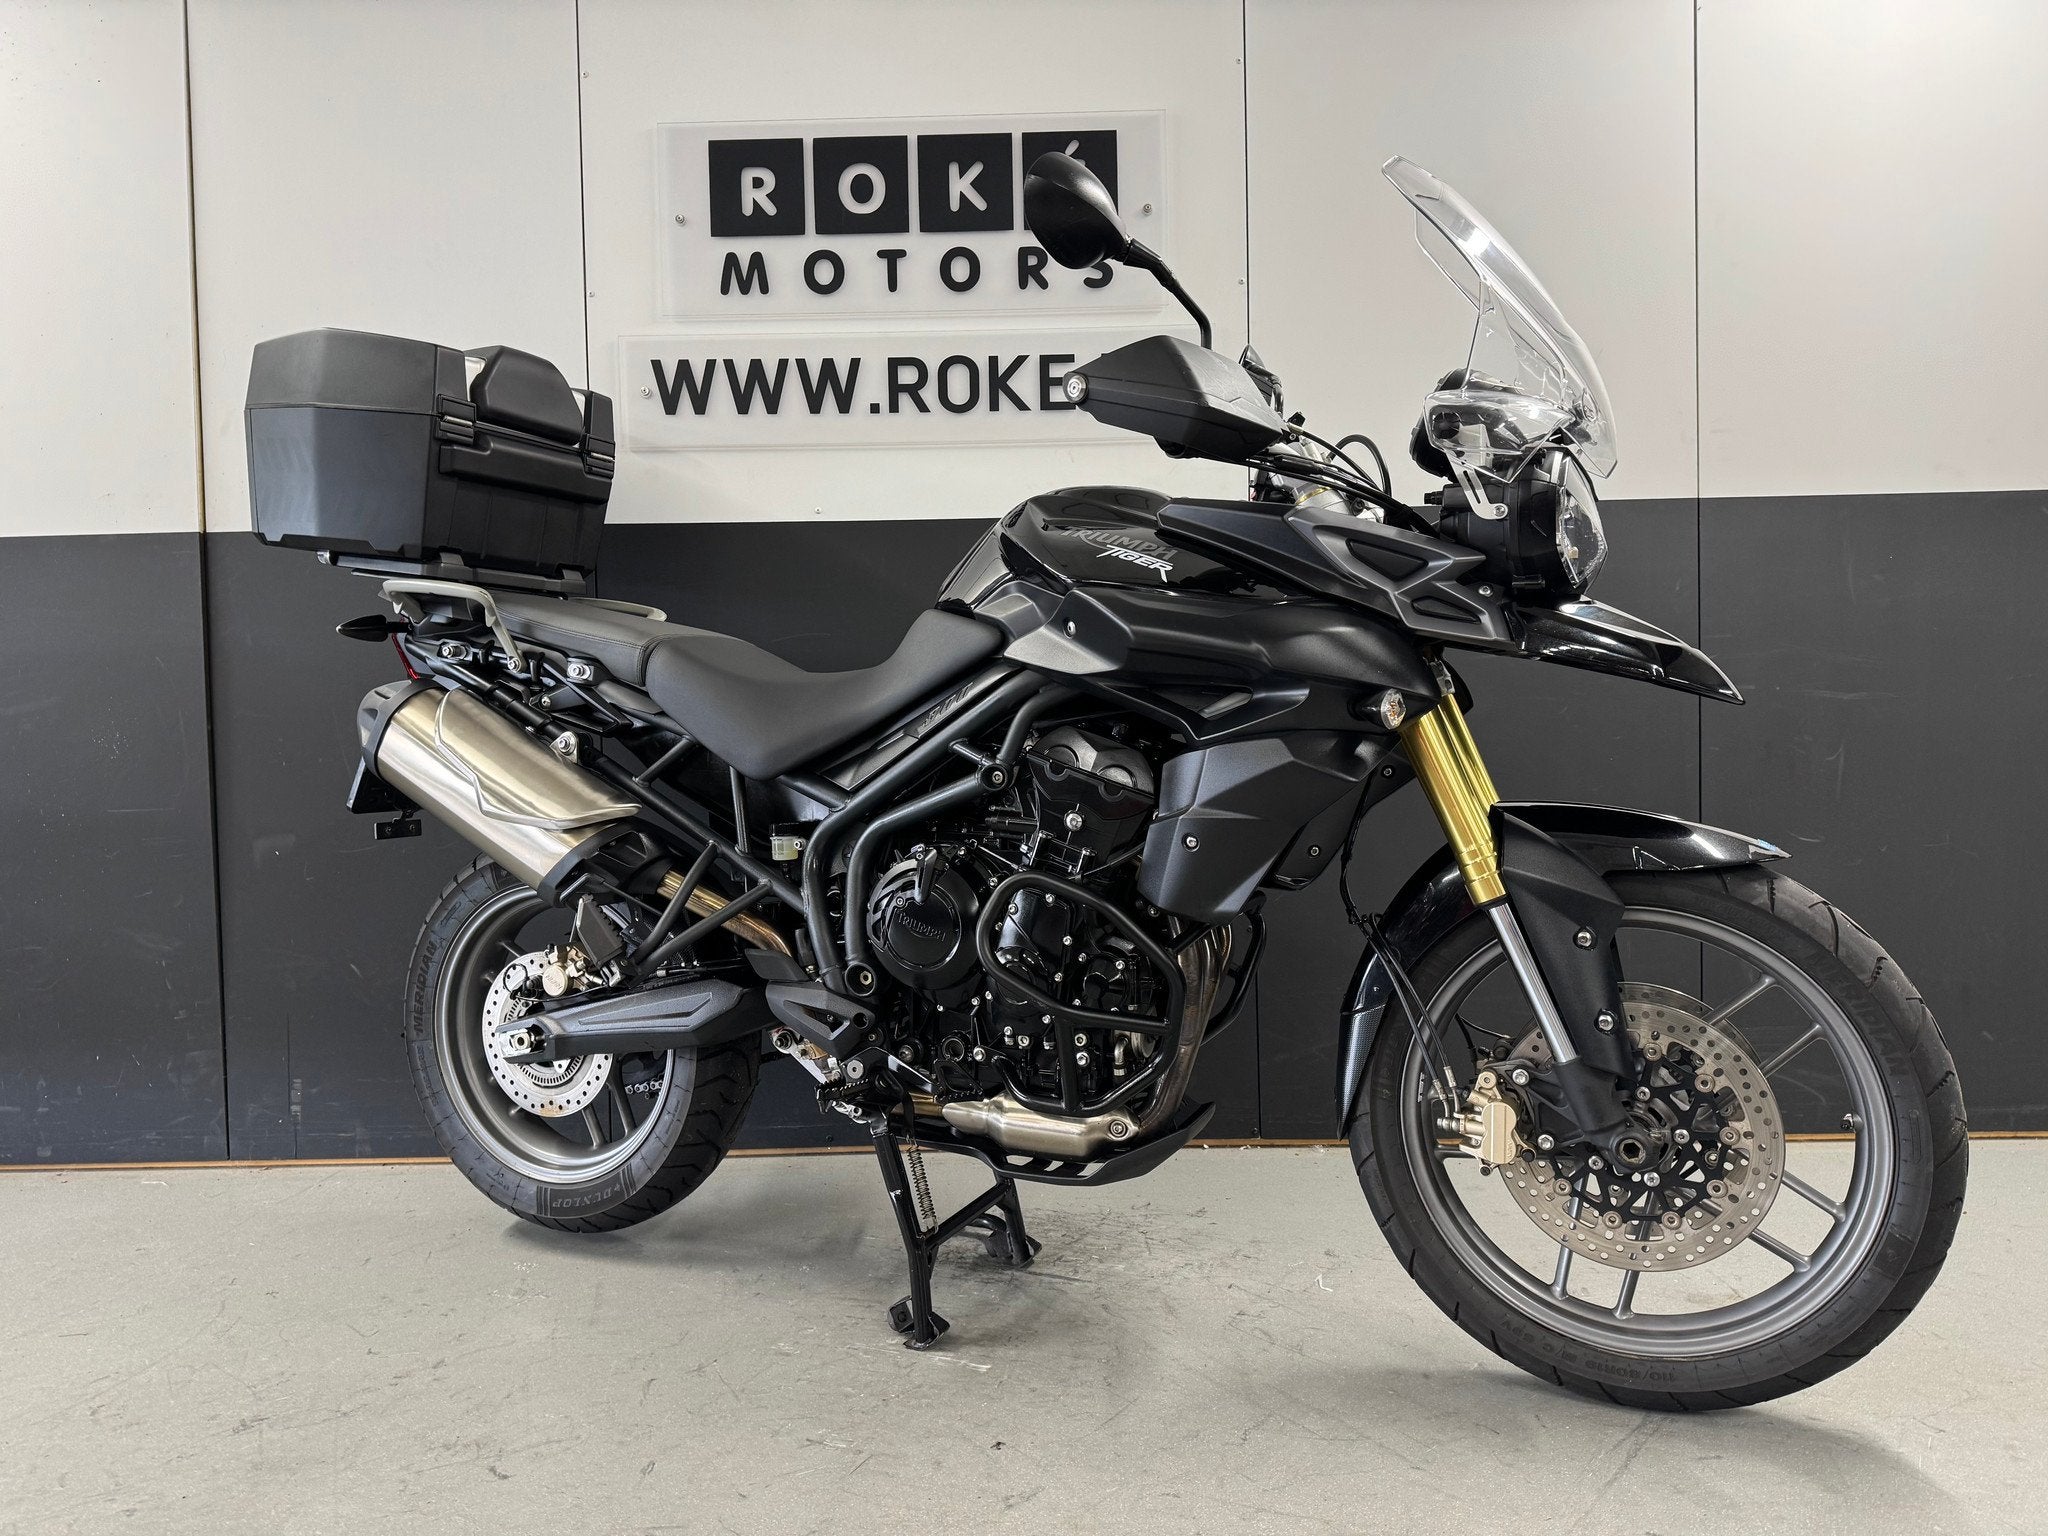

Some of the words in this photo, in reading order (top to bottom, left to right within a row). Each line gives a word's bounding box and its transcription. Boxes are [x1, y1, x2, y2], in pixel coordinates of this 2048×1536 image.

[741, 140, 1086, 217] ROK
[1060, 529, 1178, 560] TRIUMPH
[1096, 544, 1174, 583] TIGER
[898, 913, 946, 942] TRIUMPH
[413, 940, 439, 1034] MERIDIAN
[552, 1187, 612, 1208] DUNLOP
